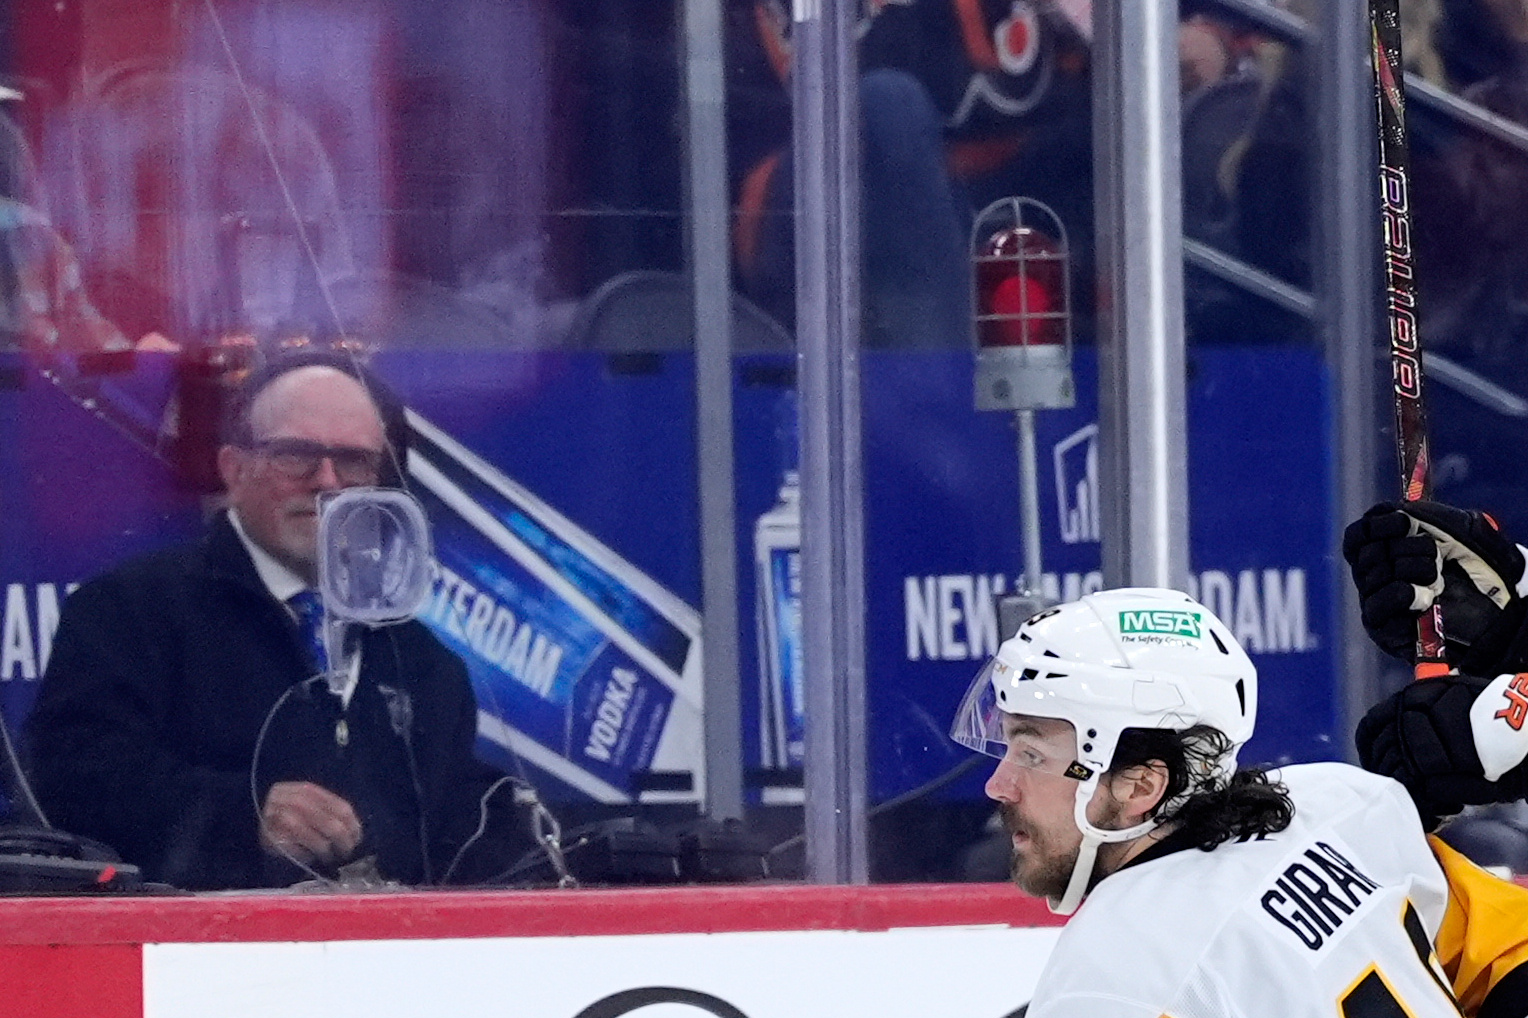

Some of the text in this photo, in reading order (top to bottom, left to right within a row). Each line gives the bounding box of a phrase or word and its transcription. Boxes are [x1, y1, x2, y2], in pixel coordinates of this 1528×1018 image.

[905, 573, 1003, 661] NEW
[1122, 610, 1199, 637] MSA
[584, 666, 640, 763] VODKA
